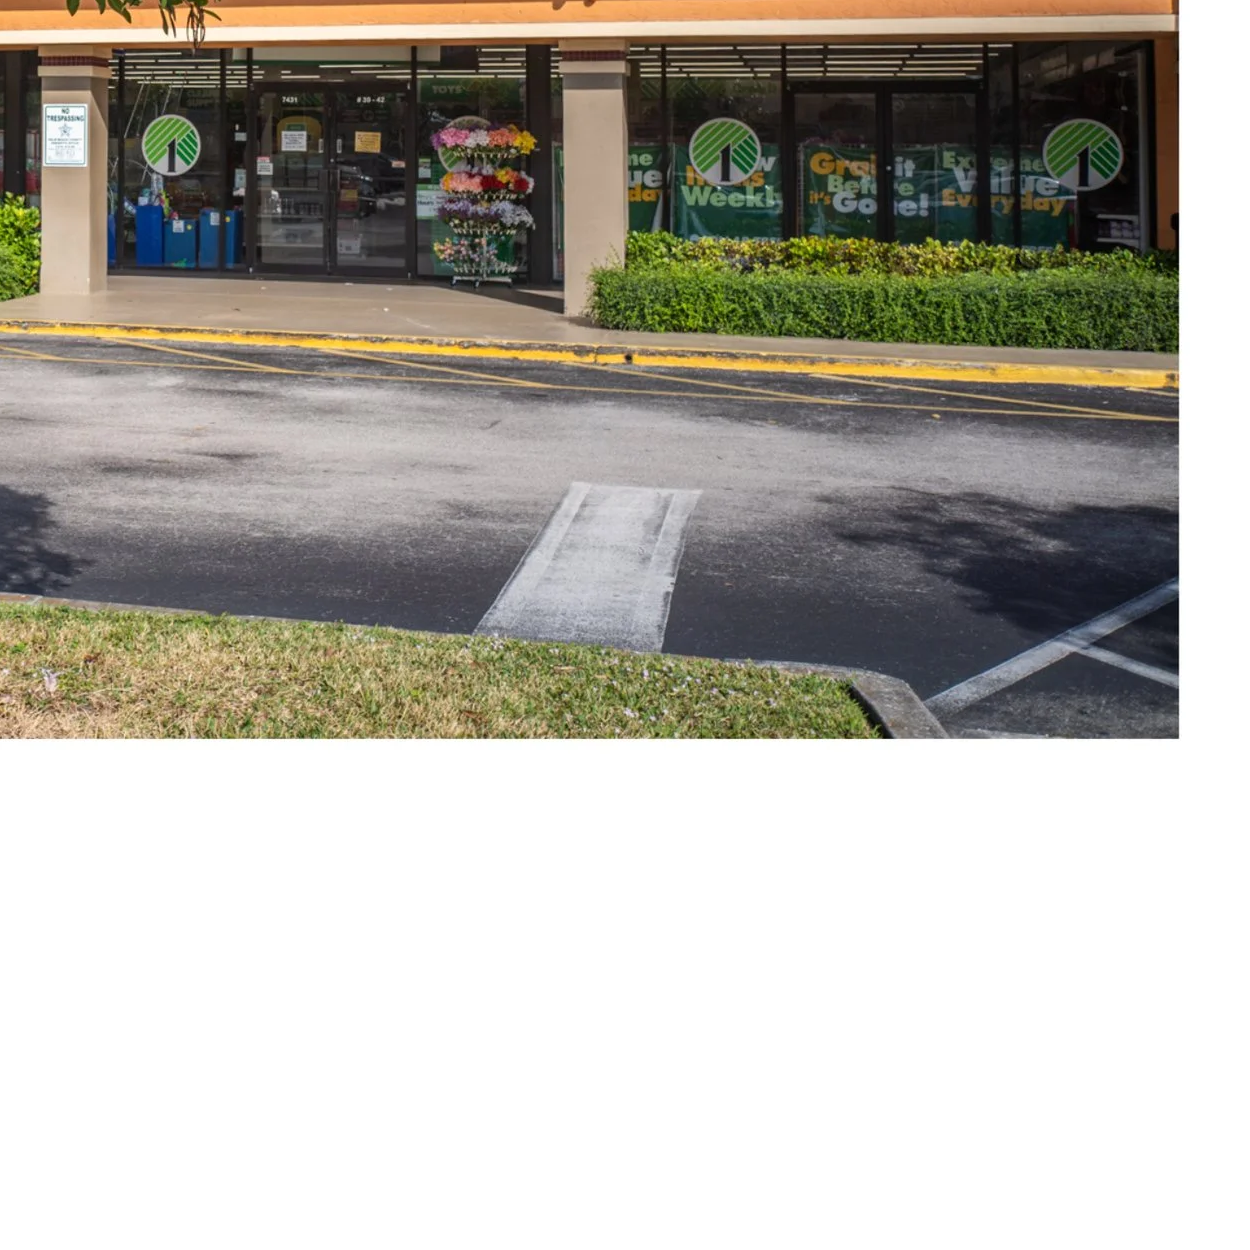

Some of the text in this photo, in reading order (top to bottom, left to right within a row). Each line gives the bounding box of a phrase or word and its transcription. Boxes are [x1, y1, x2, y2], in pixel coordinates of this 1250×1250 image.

[432, 85, 462, 94] TOYS
[828, 174, 915, 196] Befe
[832, 191, 929, 217] Goe!
[942, 188, 1067, 217] Evryday
